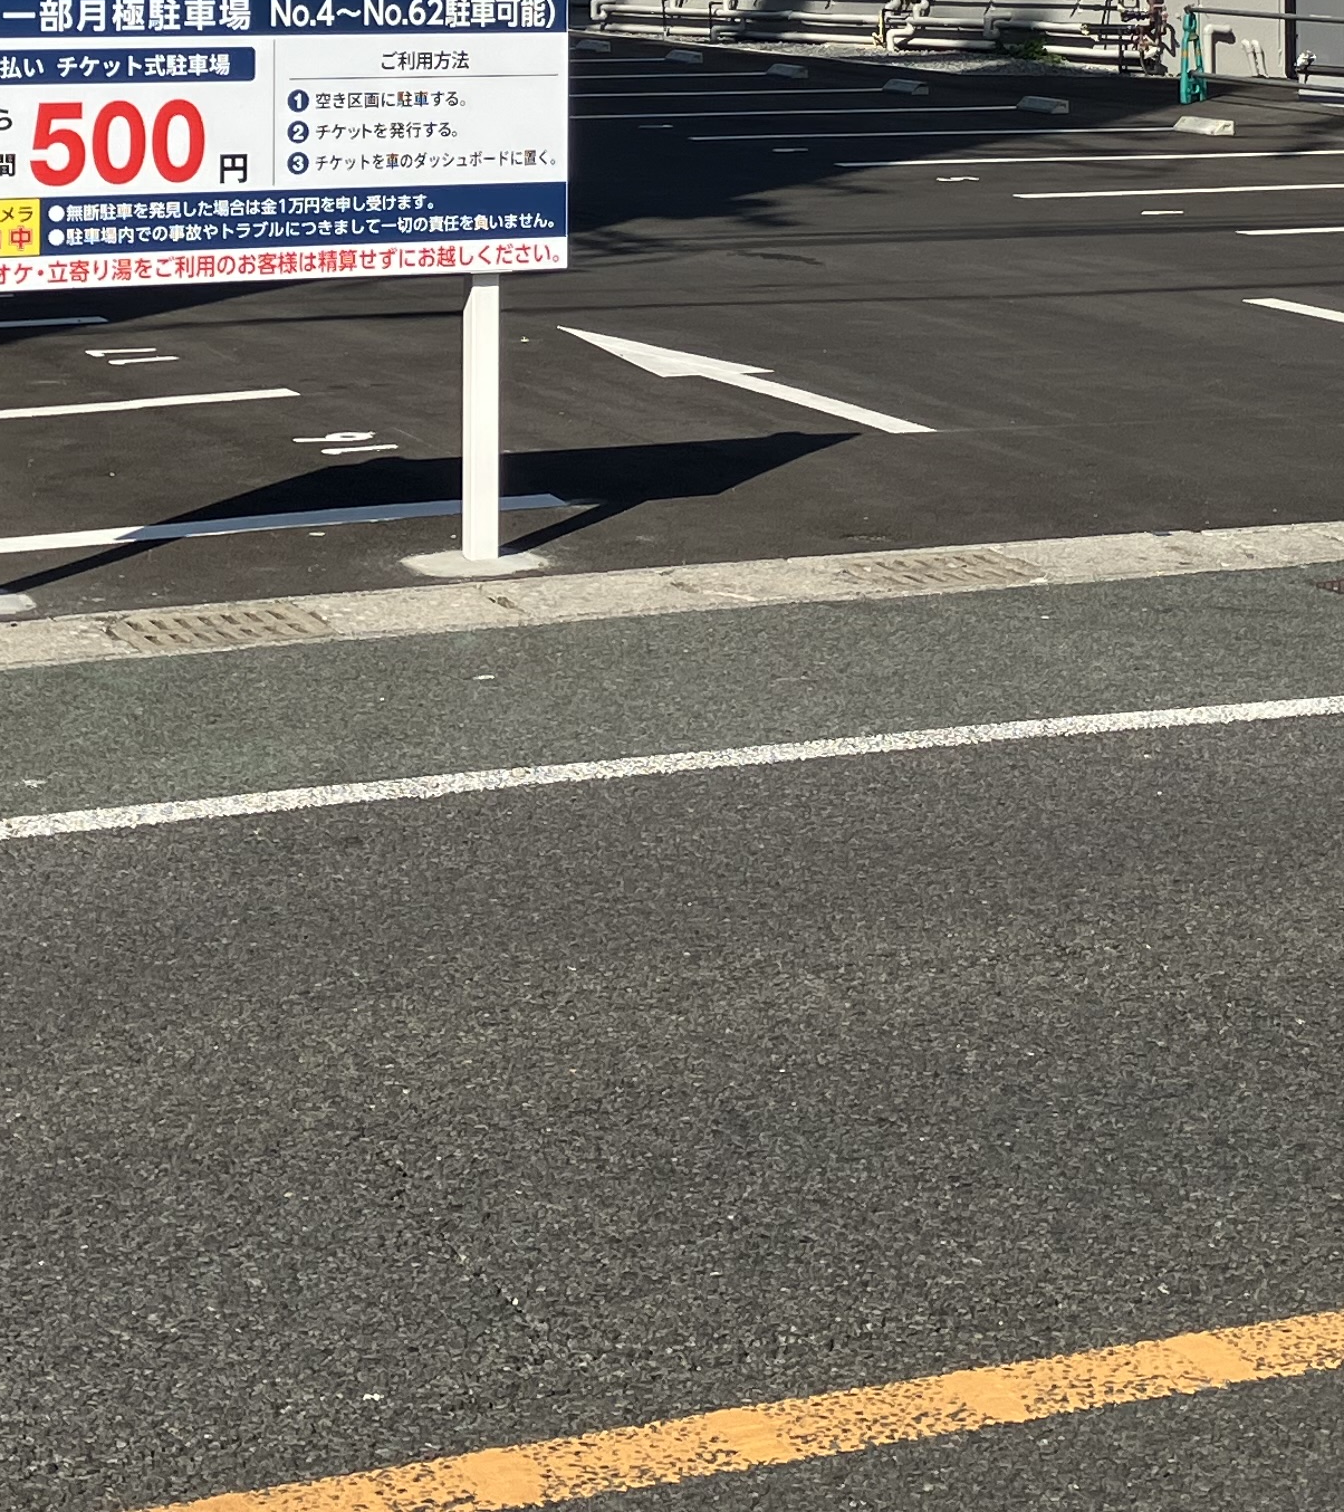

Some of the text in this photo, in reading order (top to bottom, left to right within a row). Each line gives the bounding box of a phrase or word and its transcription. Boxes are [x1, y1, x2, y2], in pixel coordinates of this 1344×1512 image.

[57, 52, 231, 79] チケット式駐車場
[381, 50, 470, 71] ご利用方法
[315, 90, 466, 109] 空き区画に駐車する。
[316, 121, 458, 140] チケットを発行する。
[315, 149, 557, 171] チケットを車のダッシュボードに置く。
[66, 194, 439, 223] 無断駐車を発見した場合は金1万円を申し受けます。
